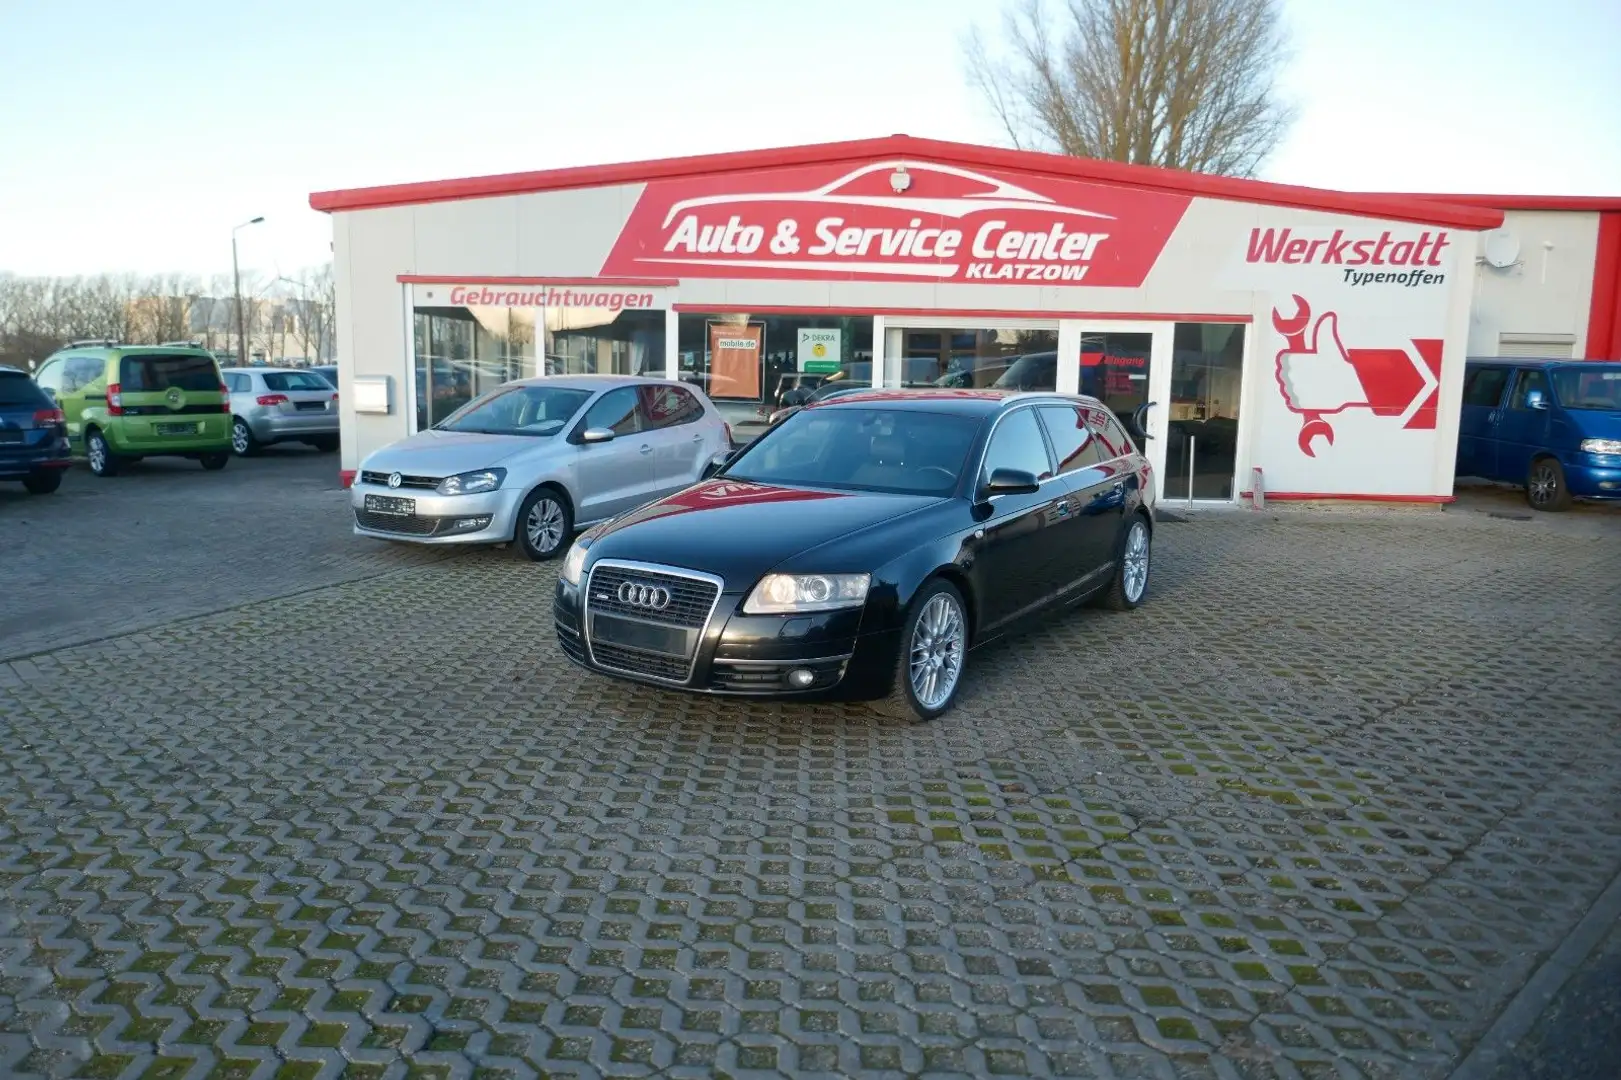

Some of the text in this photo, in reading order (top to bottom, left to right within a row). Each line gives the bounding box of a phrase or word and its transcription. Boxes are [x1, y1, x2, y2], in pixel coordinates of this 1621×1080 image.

[663, 215, 1110, 261] Auto & Service Center
[1245, 227, 1451, 267] Werkstatt
[965, 262, 1089, 281] KLATZOW
[1342, 268, 1445, 288] Typenoffen
[450, 286, 654, 312] Gebrauchtwagen
[720, 340, 756, 348] mobile.de
[811, 333, 836, 342] DEKRA
